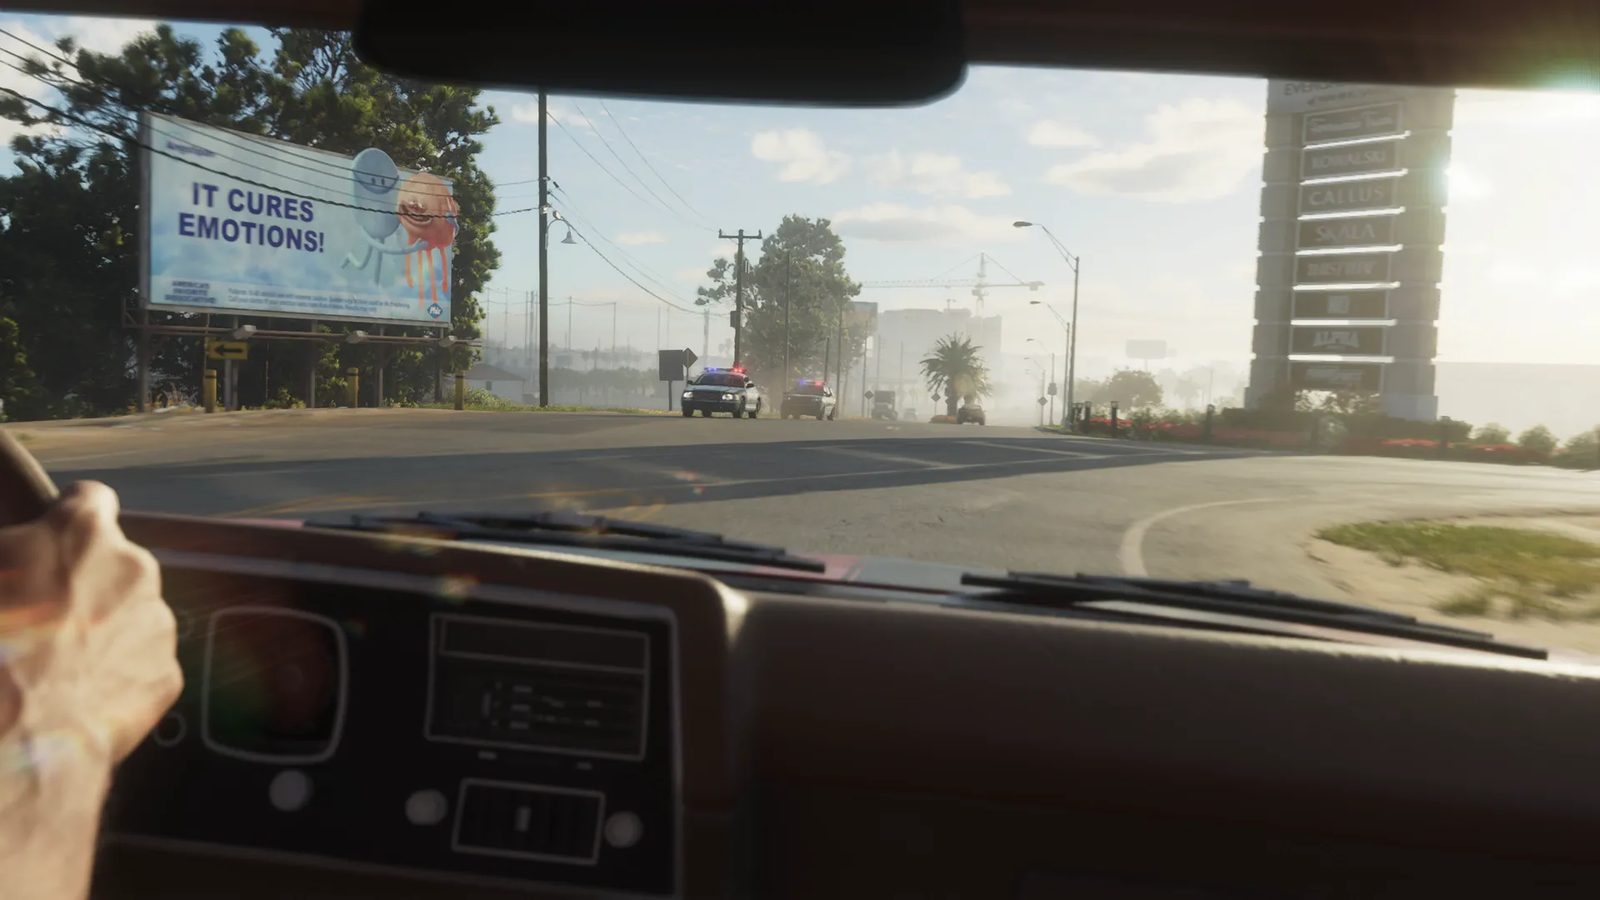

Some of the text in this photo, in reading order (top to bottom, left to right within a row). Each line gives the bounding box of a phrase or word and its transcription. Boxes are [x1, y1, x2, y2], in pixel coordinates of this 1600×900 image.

[193, 182, 314, 223] IT CURES
[1309, 186, 1384, 206] CALLUS
[178, 212, 324, 253] EMOTIONS!
